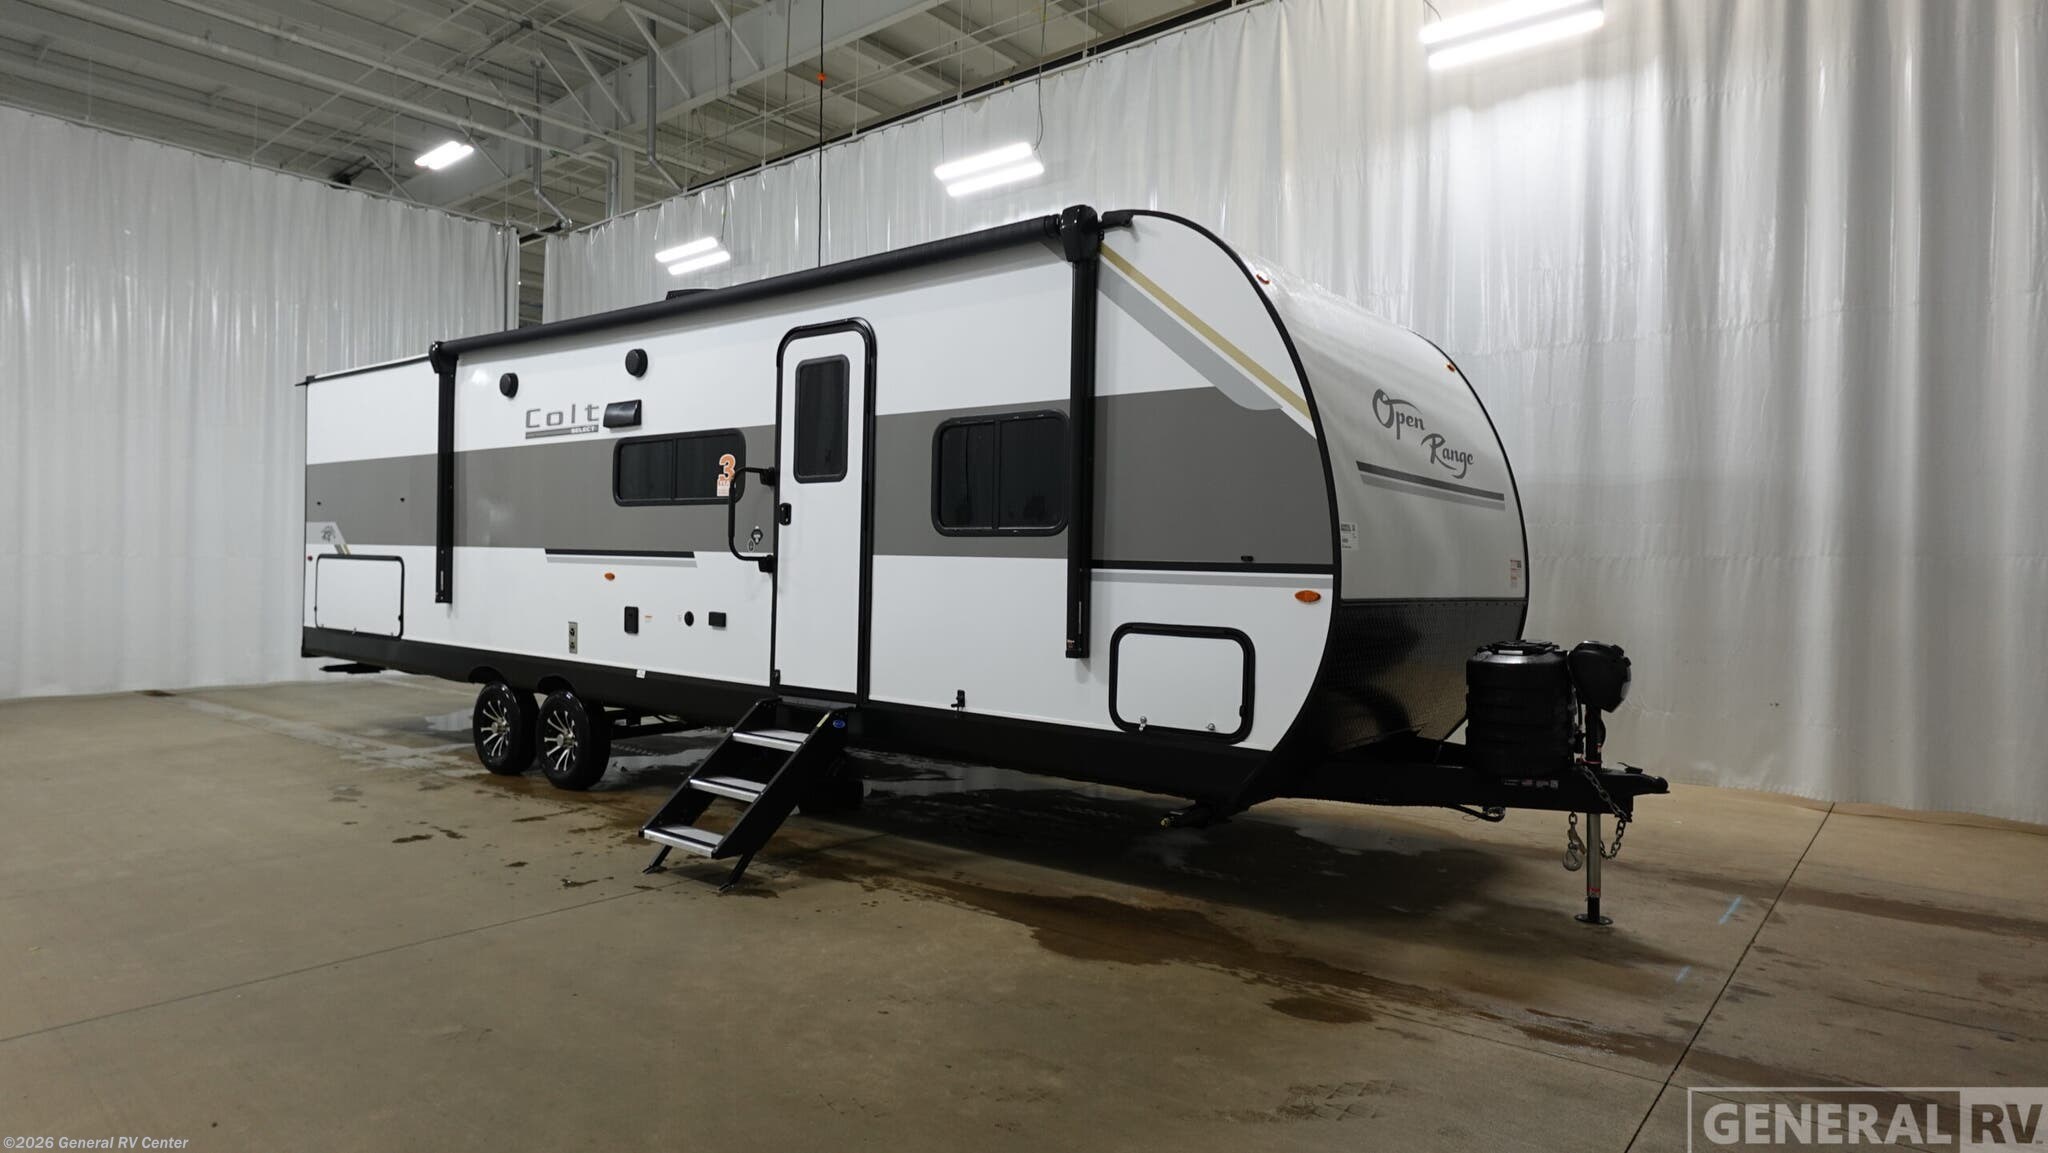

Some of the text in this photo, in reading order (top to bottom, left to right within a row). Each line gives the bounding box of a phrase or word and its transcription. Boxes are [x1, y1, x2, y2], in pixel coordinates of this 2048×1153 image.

[525, 403, 600, 429] Colt
[1372, 388, 1426, 440] Open
[571, 425, 595, 434] SELECT
[719, 453, 736, 481] 3
[1420, 433, 1474, 479] Range
